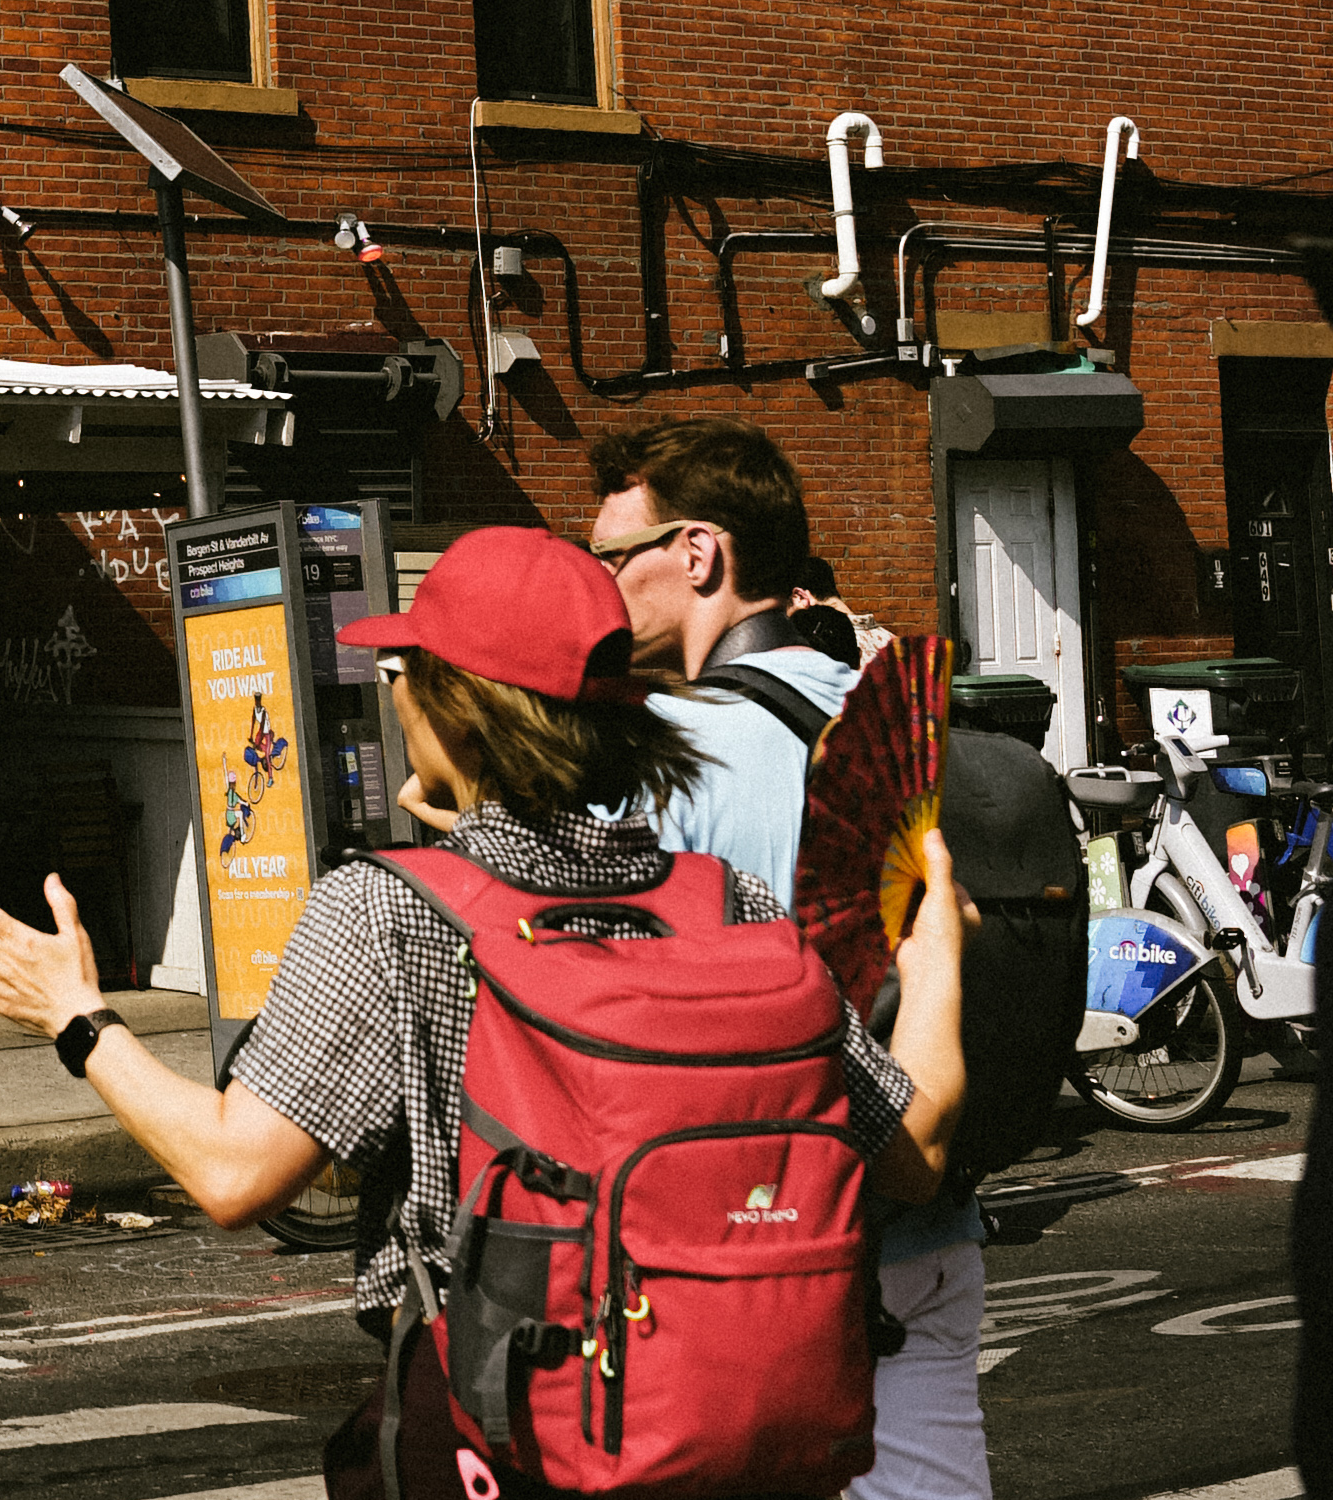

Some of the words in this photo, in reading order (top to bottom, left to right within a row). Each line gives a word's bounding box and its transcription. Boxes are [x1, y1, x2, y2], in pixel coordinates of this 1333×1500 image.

[1250, 521, 1271, 535] 601
[186, 543, 210, 557] Bergen
[211, 541, 219, 551] St
[225, 533, 259, 549] Vanderbilt
[260, 532, 269, 544] Av
[188, 562, 219, 578] Prospect
[219, 557, 245, 573] Heights
[303, 564, 320, 580] 19
[1259, 552, 1270, 600] 649
[212, 646, 241, 672] RIDE
[242, 644, 266, 668] ALL
[207, 677, 236, 700] YOU
[236, 671, 275, 698] WANT
[228, 856, 251, 879] ALL
[251, 855, 287, 878] YEAR
[249, 887, 290, 901] membership
[1186, 875, 1204, 901] citi
[1201, 895, 1221, 930] bike
[1109, 940, 1136, 961] citi
[1138, 943, 1177, 964] bike
